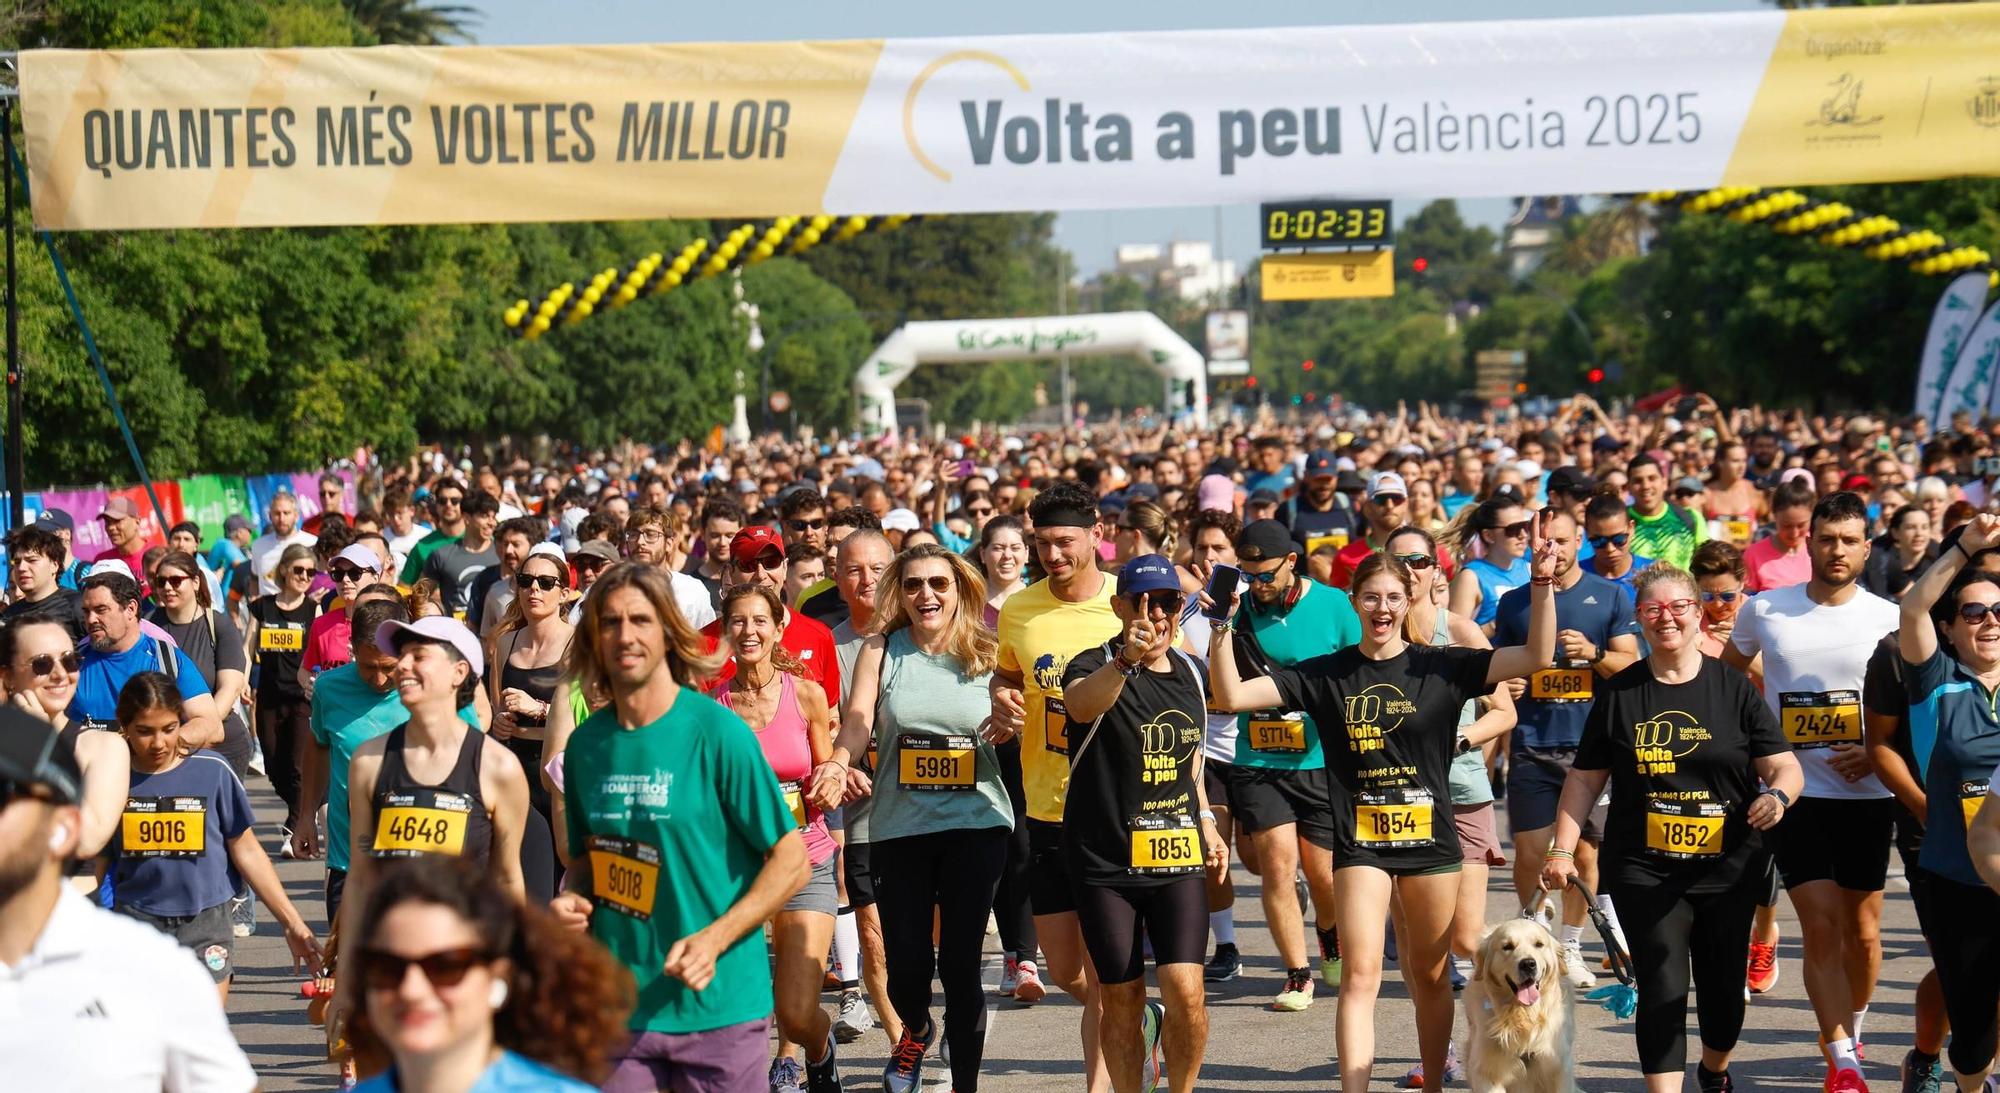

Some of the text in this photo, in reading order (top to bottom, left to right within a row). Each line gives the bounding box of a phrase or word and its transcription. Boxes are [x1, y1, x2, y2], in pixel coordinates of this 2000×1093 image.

[83, 90, 791, 178] QUANTES MÉS VOLTES MILLOR
[961, 93, 1702, 175] Volta a peu València 2025
[1268, 208, 1385, 239] 0:02:33
[269, 632, 294, 645] 1598
[1541, 674, 1582, 693] 9468
[1345, 694, 1381, 724] 100
[1258, 726, 1294, 743] 9774
[1346, 724, 1381, 739] Volta
[1635, 720, 1673, 748] 100
[1794, 712, 1847, 737] 2424
[1140, 722, 1175, 753] 100
[1350, 738, 1385, 754] a peu
[1143, 754, 1176, 769] Volta
[1635, 746, 1673, 762] Volta
[915, 756, 959, 779] 5981
[1142, 769, 1178, 786] a peu
[1637, 761, 1676, 777] a peu
[139, 820, 186, 844] 9016
[389, 815, 449, 845] 4648
[1371, 811, 1417, 835] 1854
[1663, 822, 1709, 848] 1852
[1149, 836, 1191, 860] 1853
[608, 862, 643, 901] 9018
